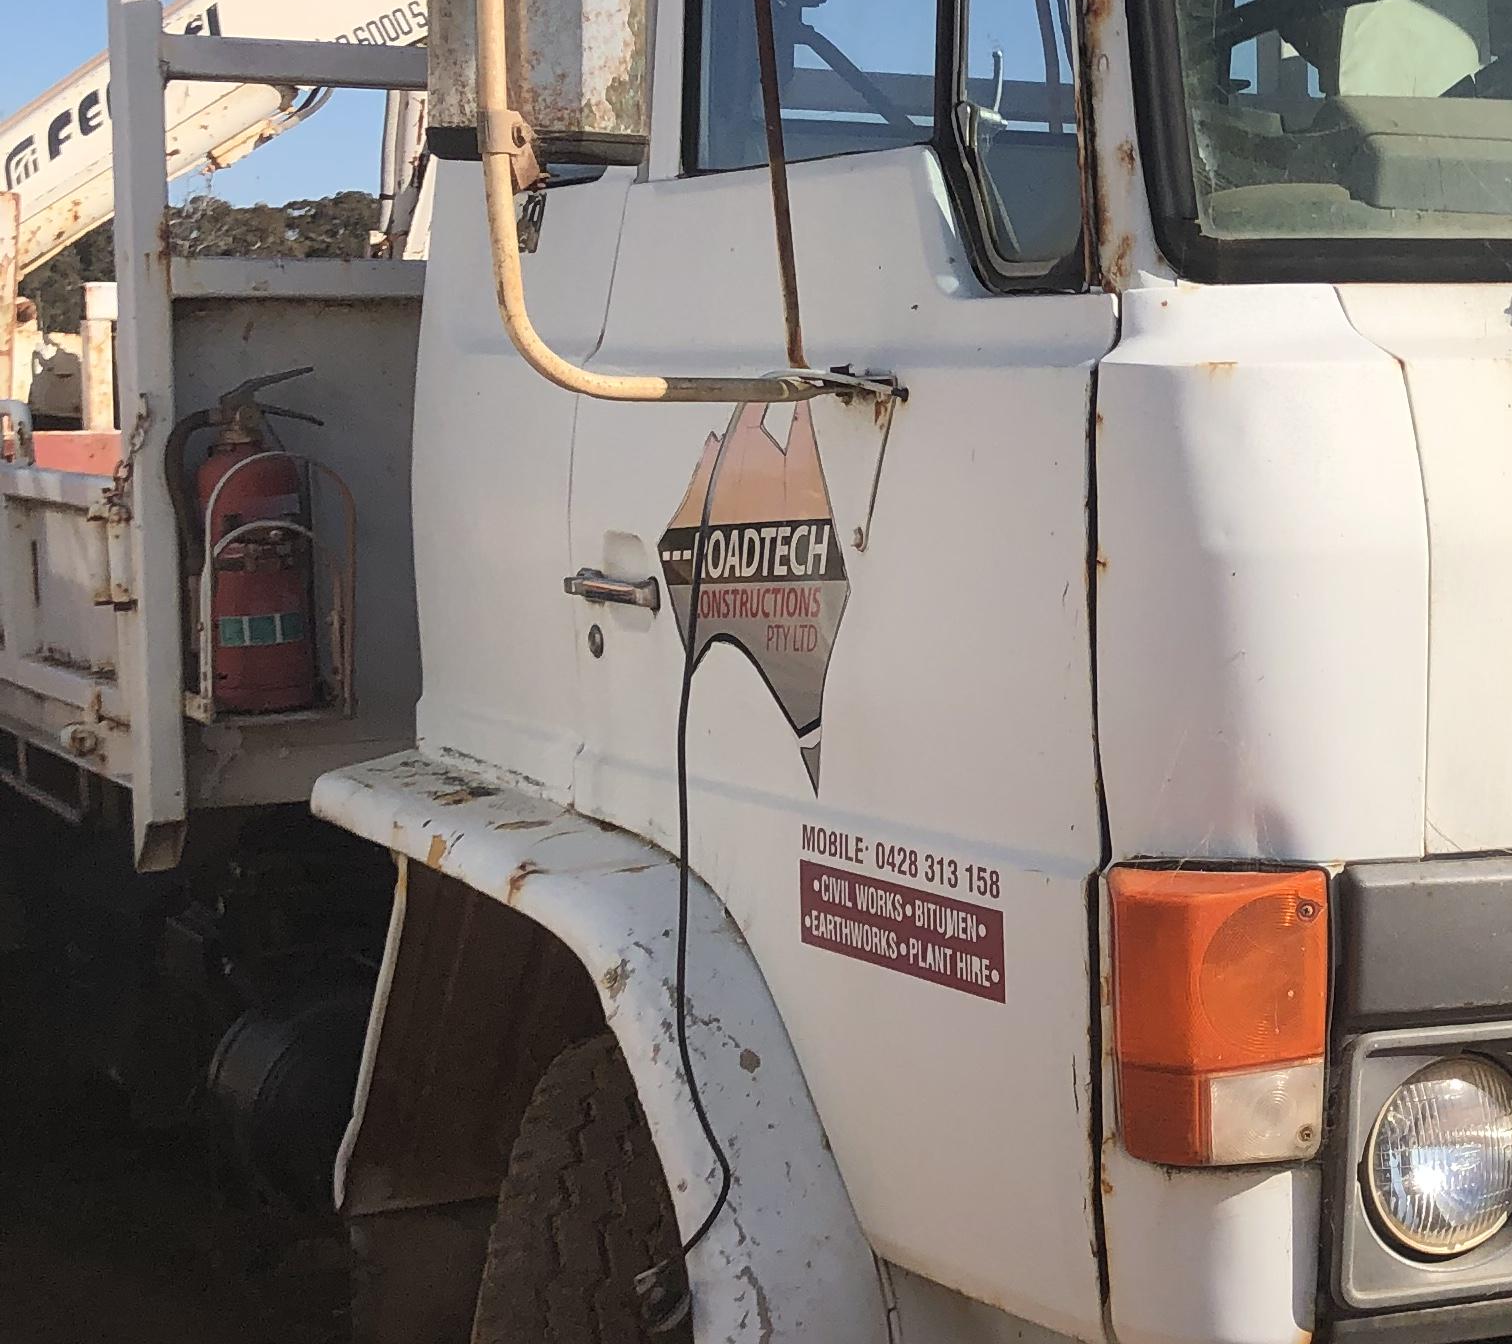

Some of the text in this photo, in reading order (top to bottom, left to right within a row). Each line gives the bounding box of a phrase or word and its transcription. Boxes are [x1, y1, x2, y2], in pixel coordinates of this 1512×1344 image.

[695, 586, 822, 619] ONSTRUCTIONS
[766, 624, 818, 653] PTY LTD
[875, 842, 918, 878] 0428
[924, 854, 959, 889] 313
[964, 864, 1001, 899] 158
[855, 883, 903, 921] WORKS
[914, 899, 977, 942] BITUMEN
[909, 938, 953, 975] PLANT
